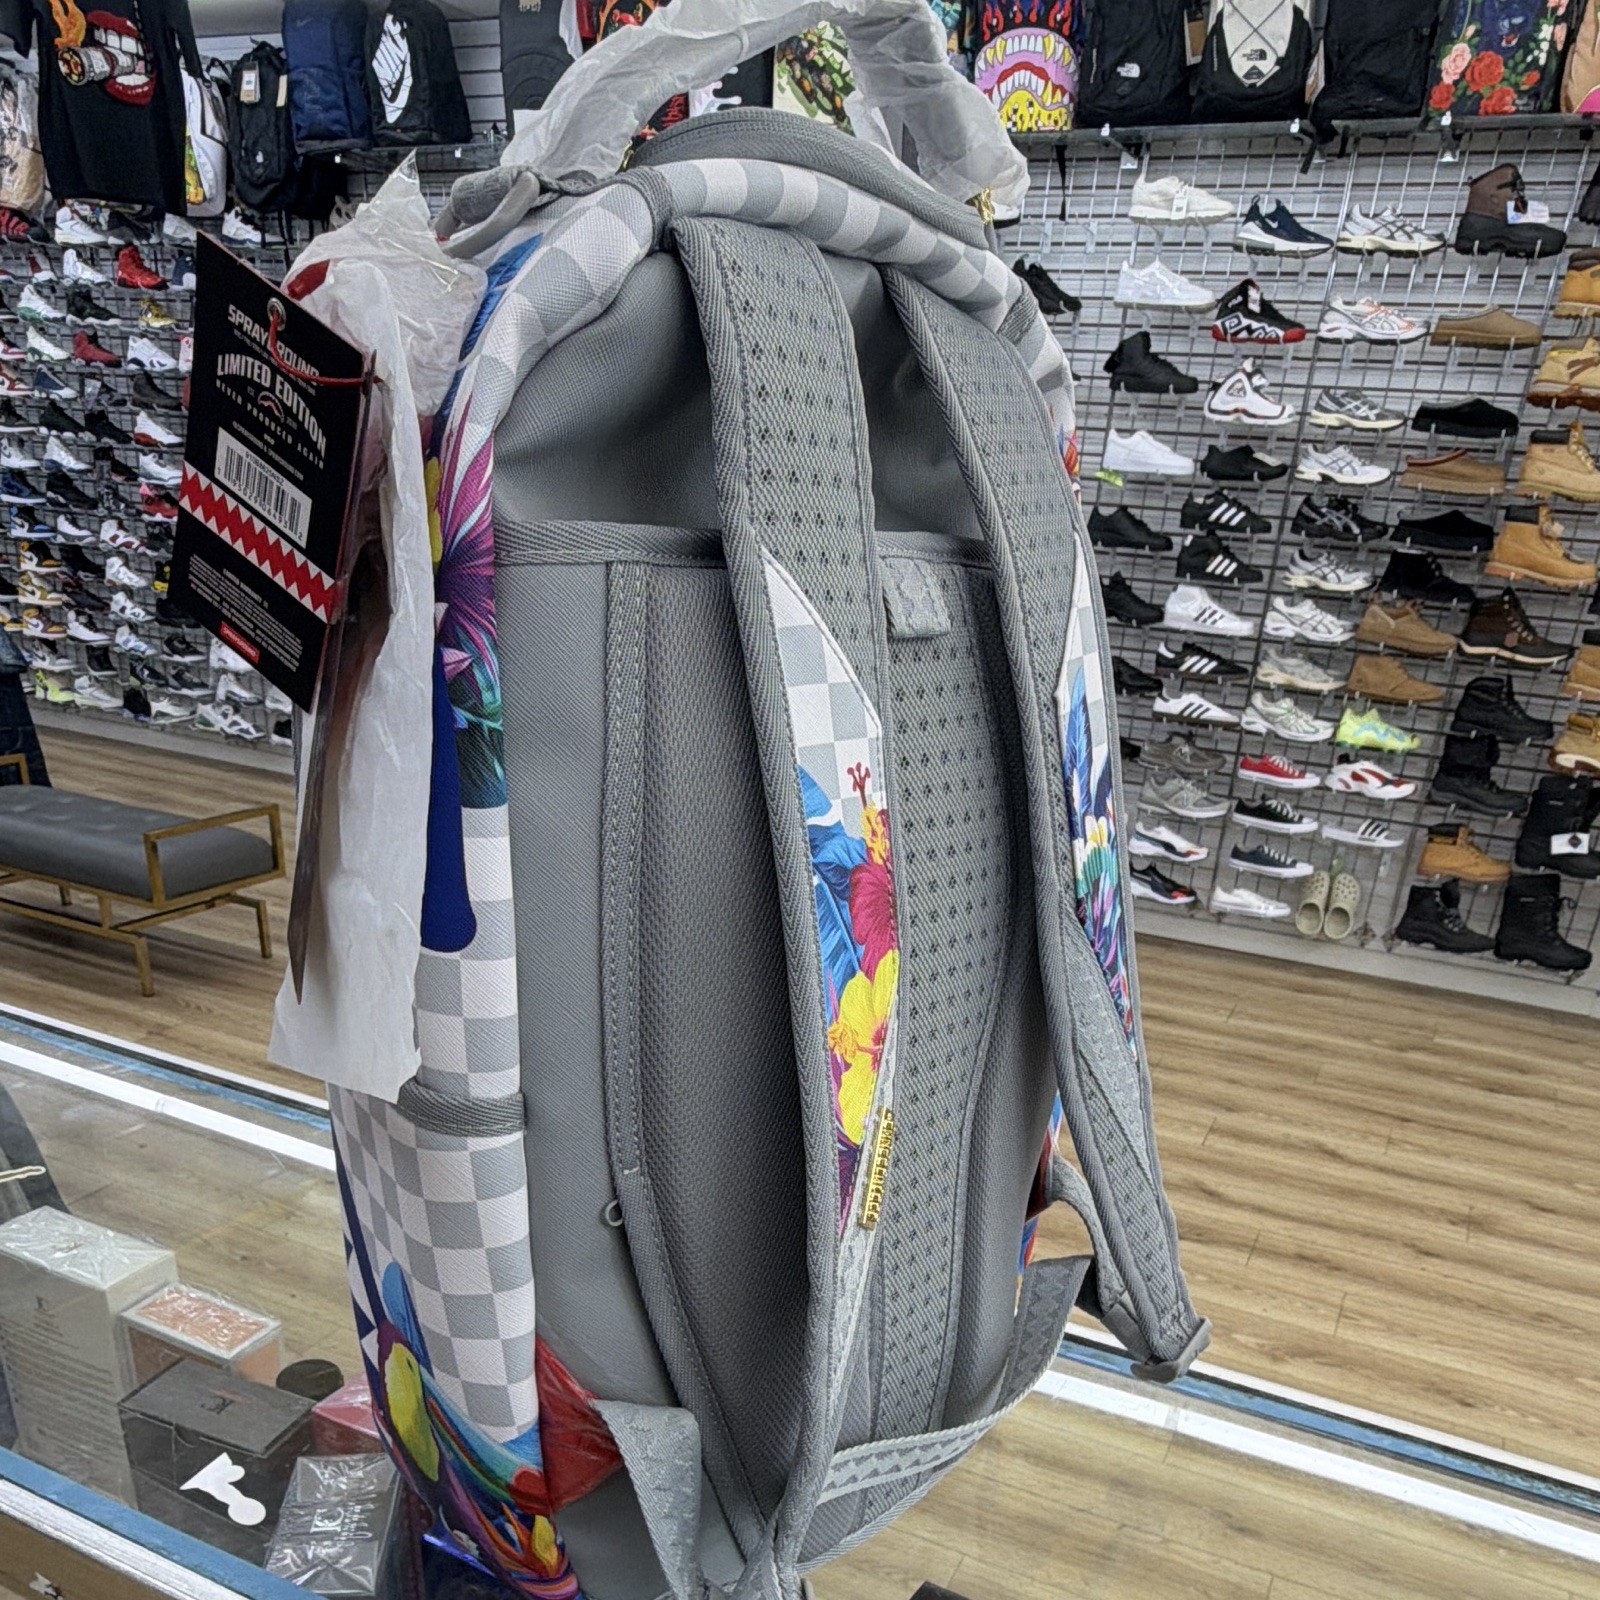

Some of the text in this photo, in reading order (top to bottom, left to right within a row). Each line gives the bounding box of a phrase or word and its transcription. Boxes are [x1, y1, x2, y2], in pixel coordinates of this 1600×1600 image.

[215, 378, 243, 405] NEVER
[246, 402, 293, 445] PRODUCED
[297, 442, 324, 470] AGAIN
[217, 353, 272, 388] LIMITED
[274, 374, 327, 459] EDITION
